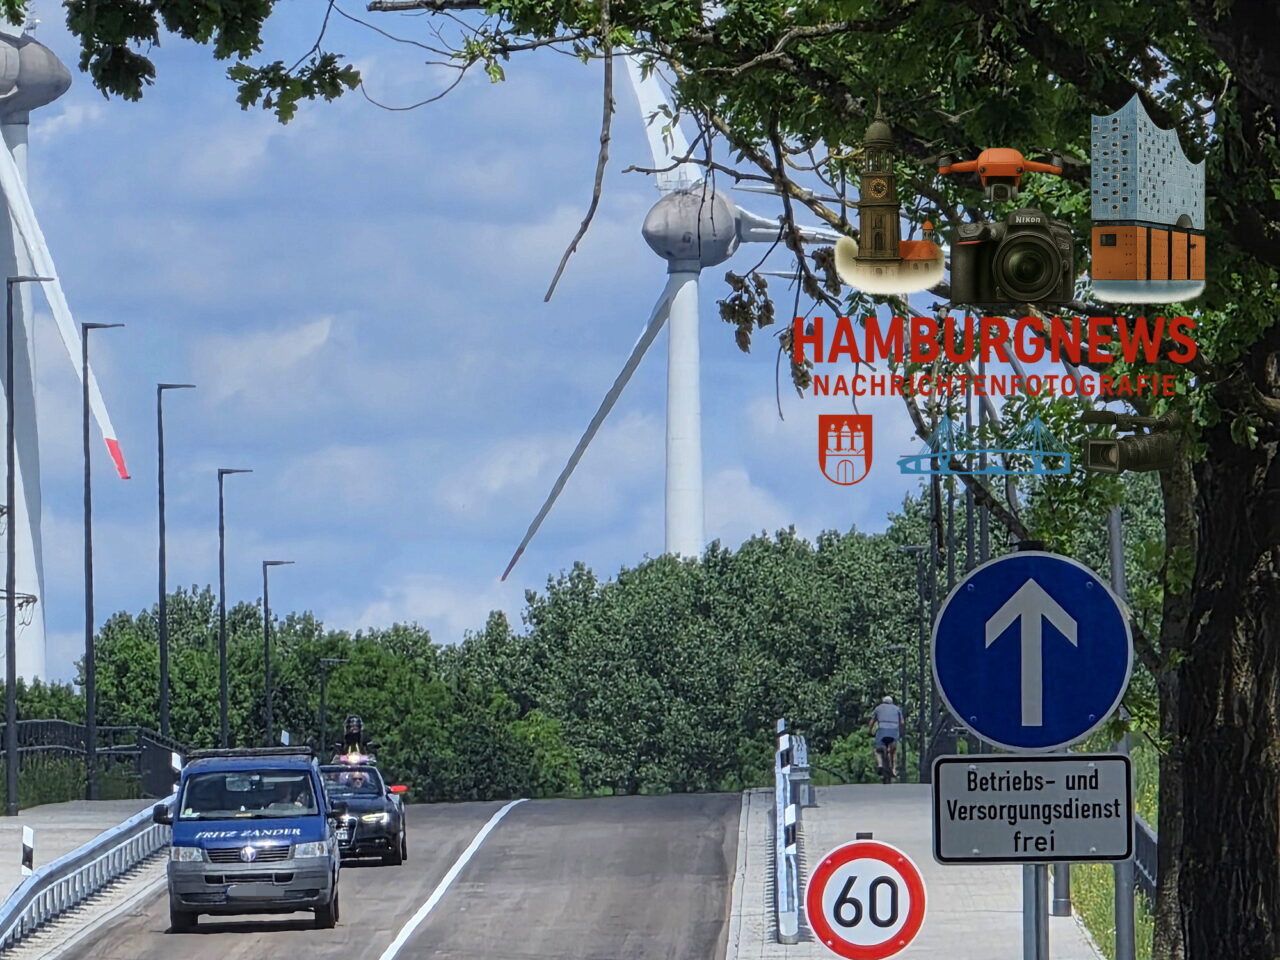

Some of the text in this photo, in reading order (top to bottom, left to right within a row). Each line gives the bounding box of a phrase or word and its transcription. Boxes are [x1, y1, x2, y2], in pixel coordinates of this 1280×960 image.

[966, 768, 1099, 793] Betriebs- und
[946, 798, 1121, 826] Versorgungsdienst
[194, 828, 301, 840] FRITZ ZANDER
[1013, 830, 1056, 853] frei
[833, 875, 899, 928] 60
